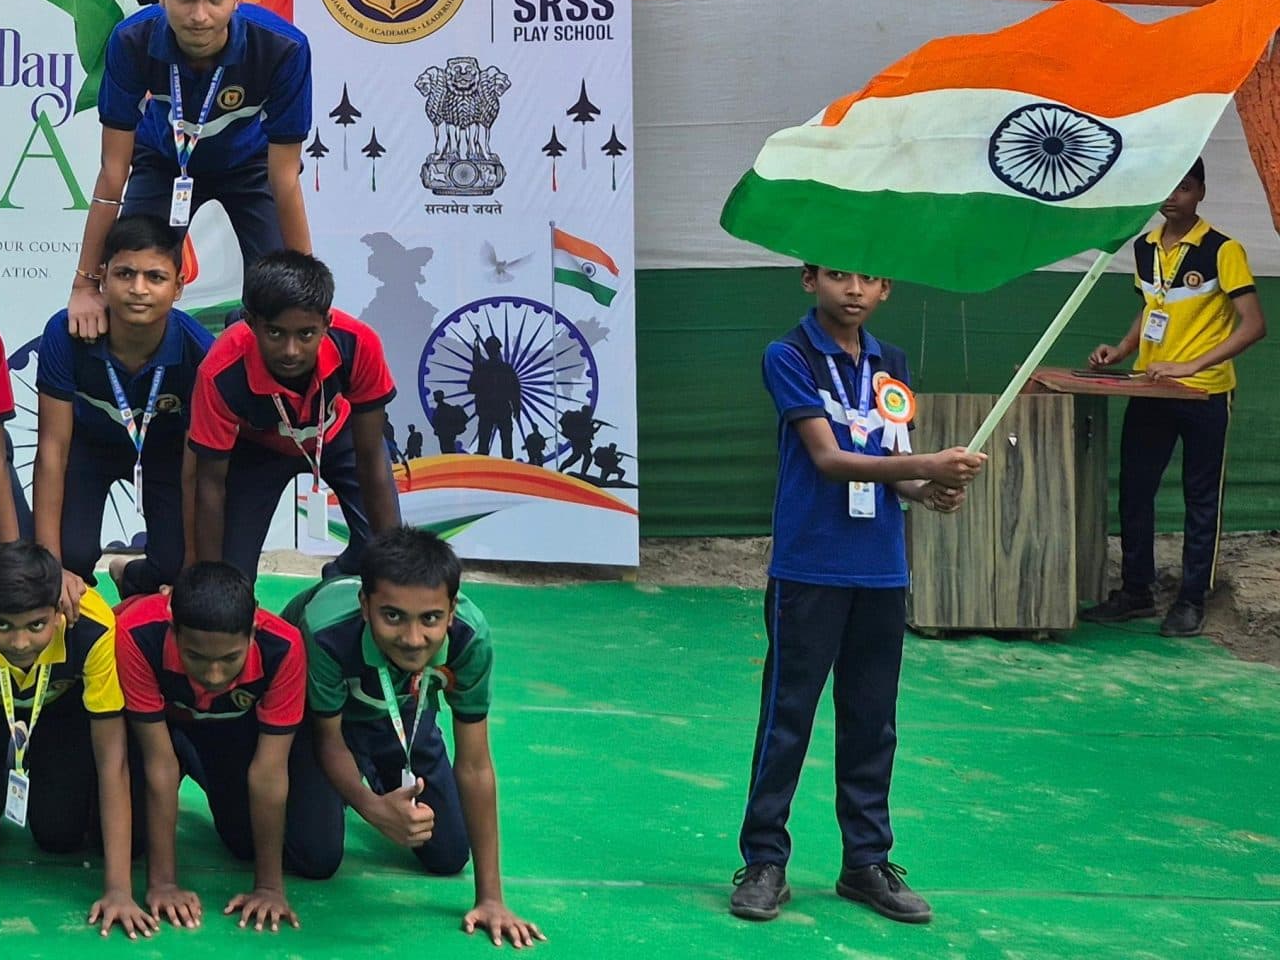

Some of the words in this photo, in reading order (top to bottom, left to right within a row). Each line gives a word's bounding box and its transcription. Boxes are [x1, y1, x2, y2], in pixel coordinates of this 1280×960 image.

[368, 26, 417, 36] ACADEMICS
[513, 25, 549, 42] PLAY
[554, 24, 614, 41] SCHOOL
[424, 200, 469, 215] सत्यमेव
[472, 200, 503, 214] जयते
[28, 241, 81, 253] COUNT
